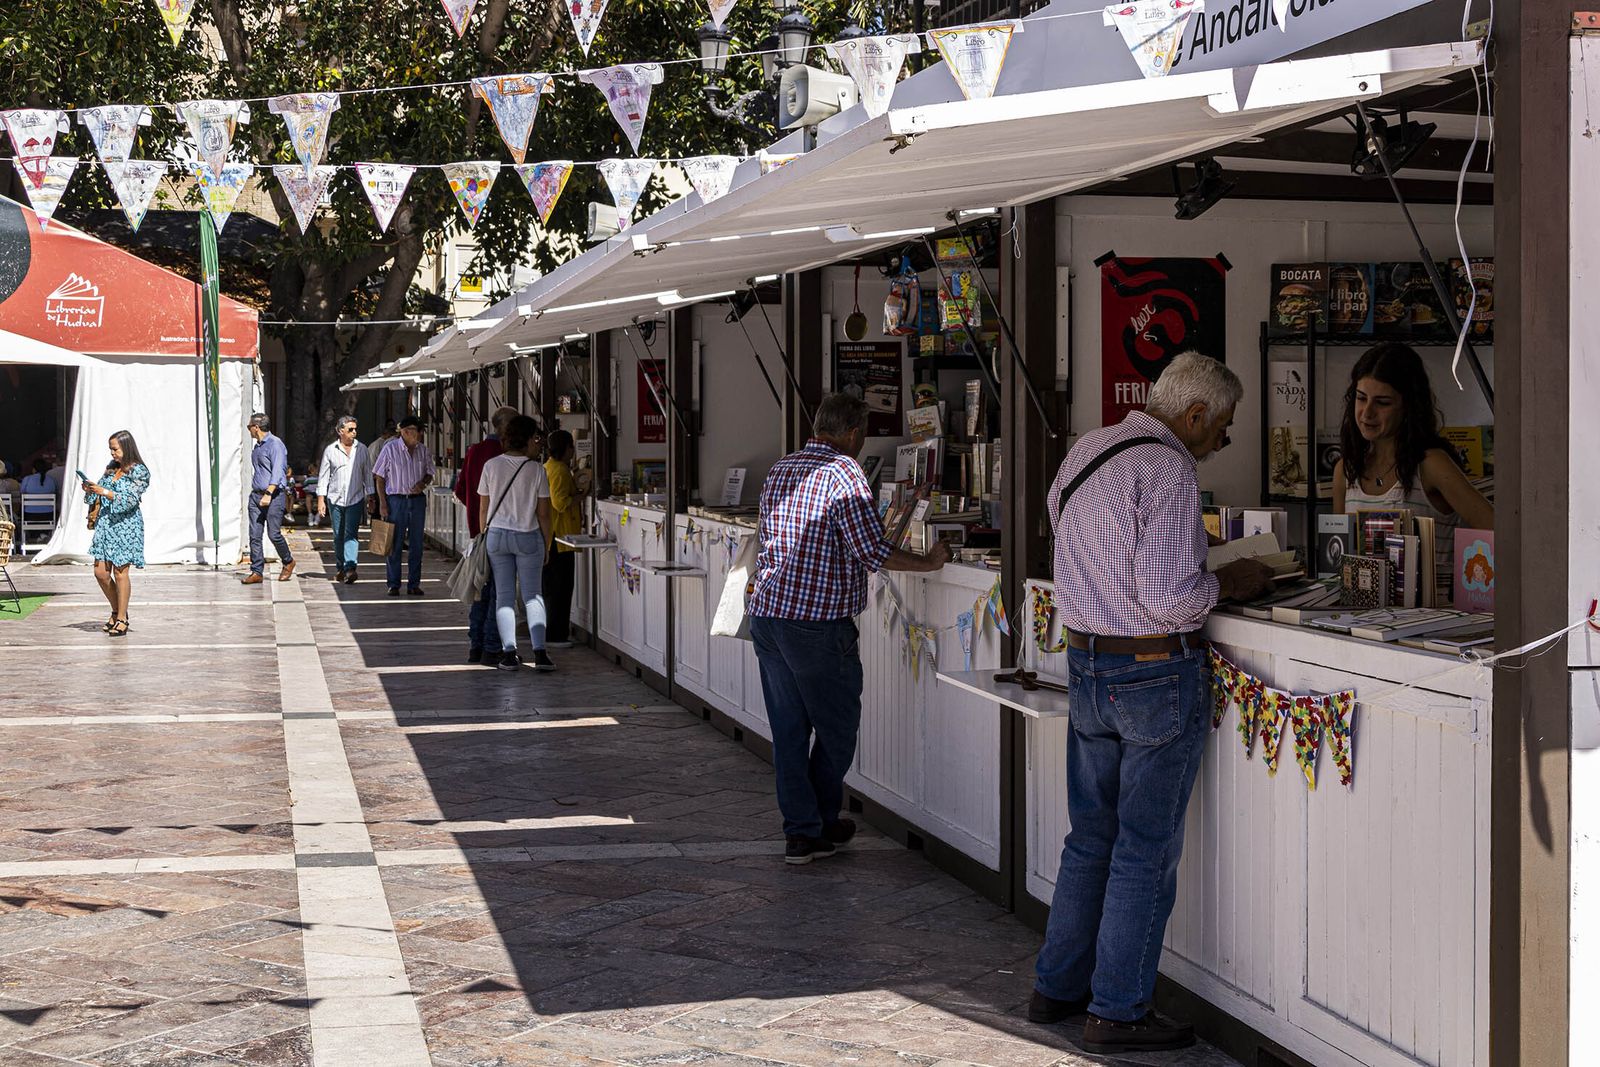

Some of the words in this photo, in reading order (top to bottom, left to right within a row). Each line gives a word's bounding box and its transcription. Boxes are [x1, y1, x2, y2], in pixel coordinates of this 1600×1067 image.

[965, 39, 986, 47] Libro
[865, 47, 883, 55] Libro
[1280, 269, 1322, 281] BOCATA
[1337, 288, 1367, 300] libro
[1330, 300, 1341, 311] el
[1343, 302, 1368, 314] pan
[1277, 386, 1306, 395] NADA
[643, 414, 664, 426] FERIA
